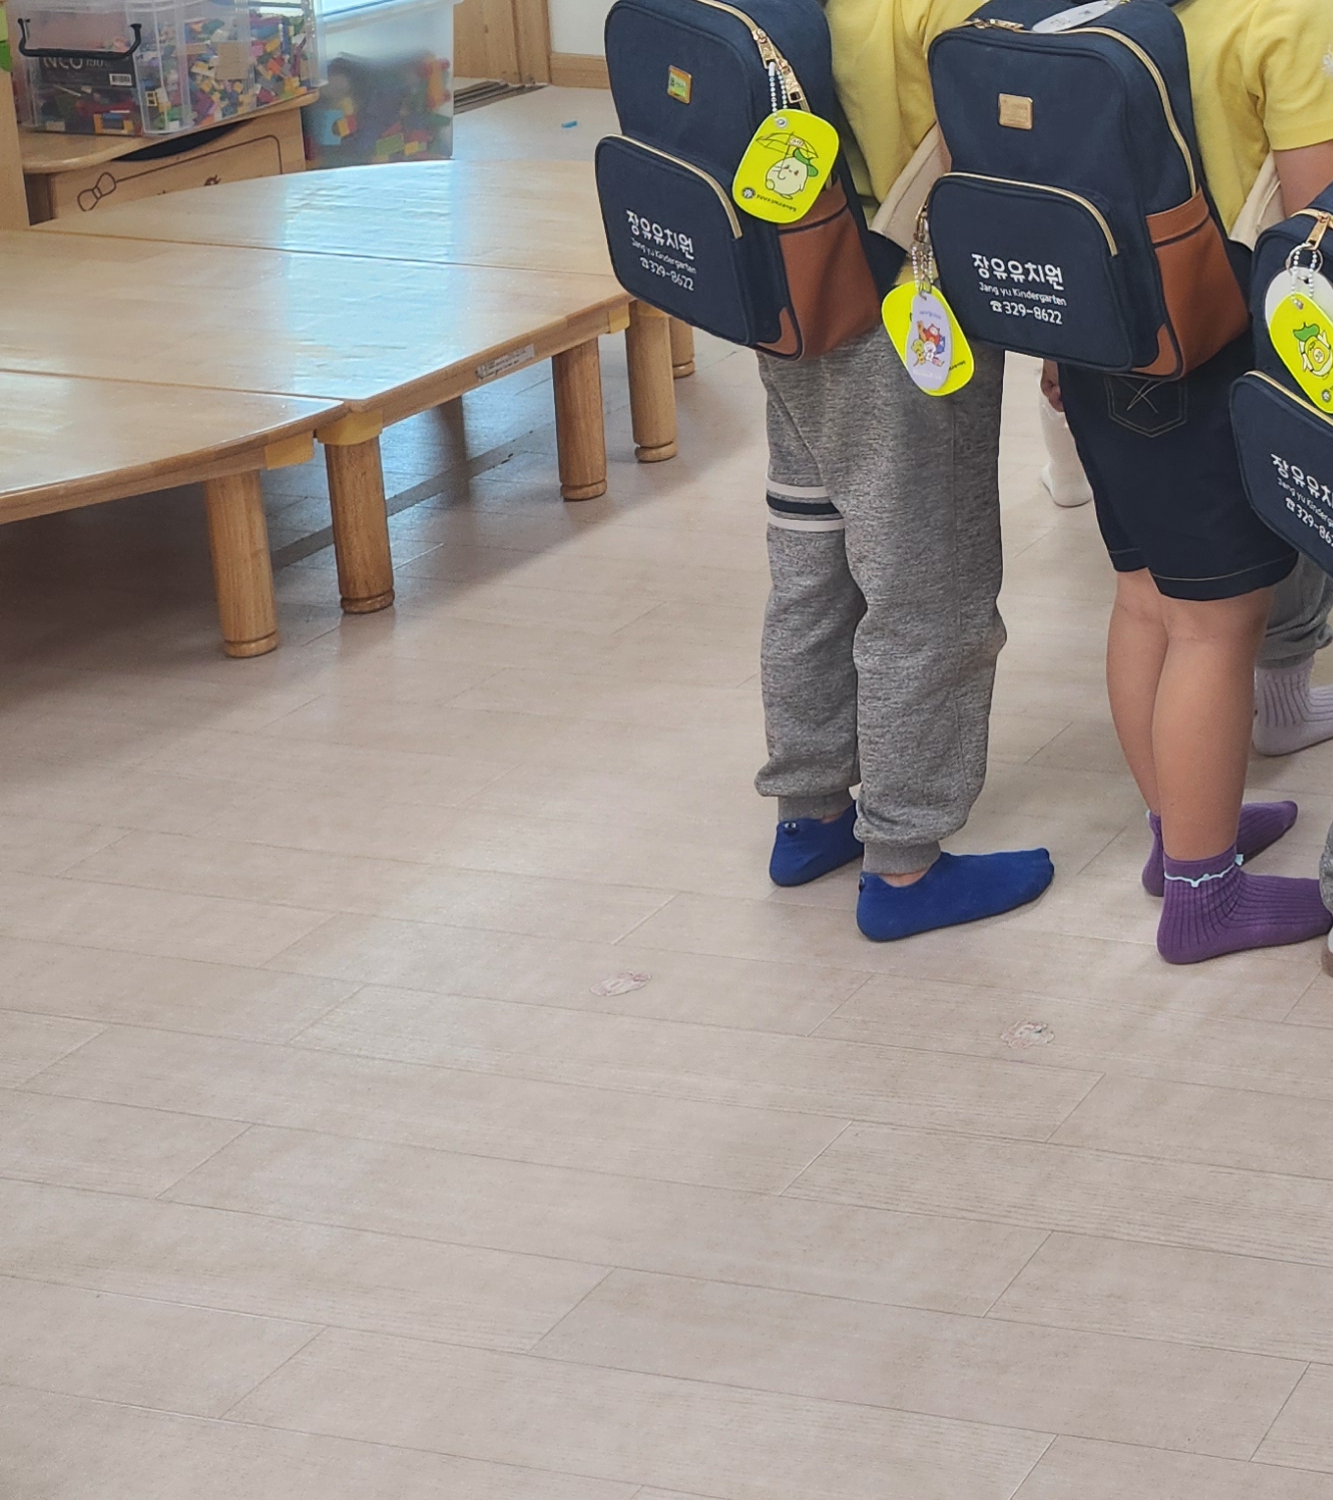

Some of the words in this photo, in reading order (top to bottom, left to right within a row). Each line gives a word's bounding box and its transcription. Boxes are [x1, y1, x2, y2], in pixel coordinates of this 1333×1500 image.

[626, 209, 694, 260] 장유유치원
[648, 260, 694, 291] 329-8622
[971, 253, 1065, 291] 장유유치원
[979, 281, 999, 296] Jang
[1000, 288, 1012, 297] yu
[1012, 288, 1068, 306] Kindergarten
[1002, 301, 1063, 325] 329-8622
